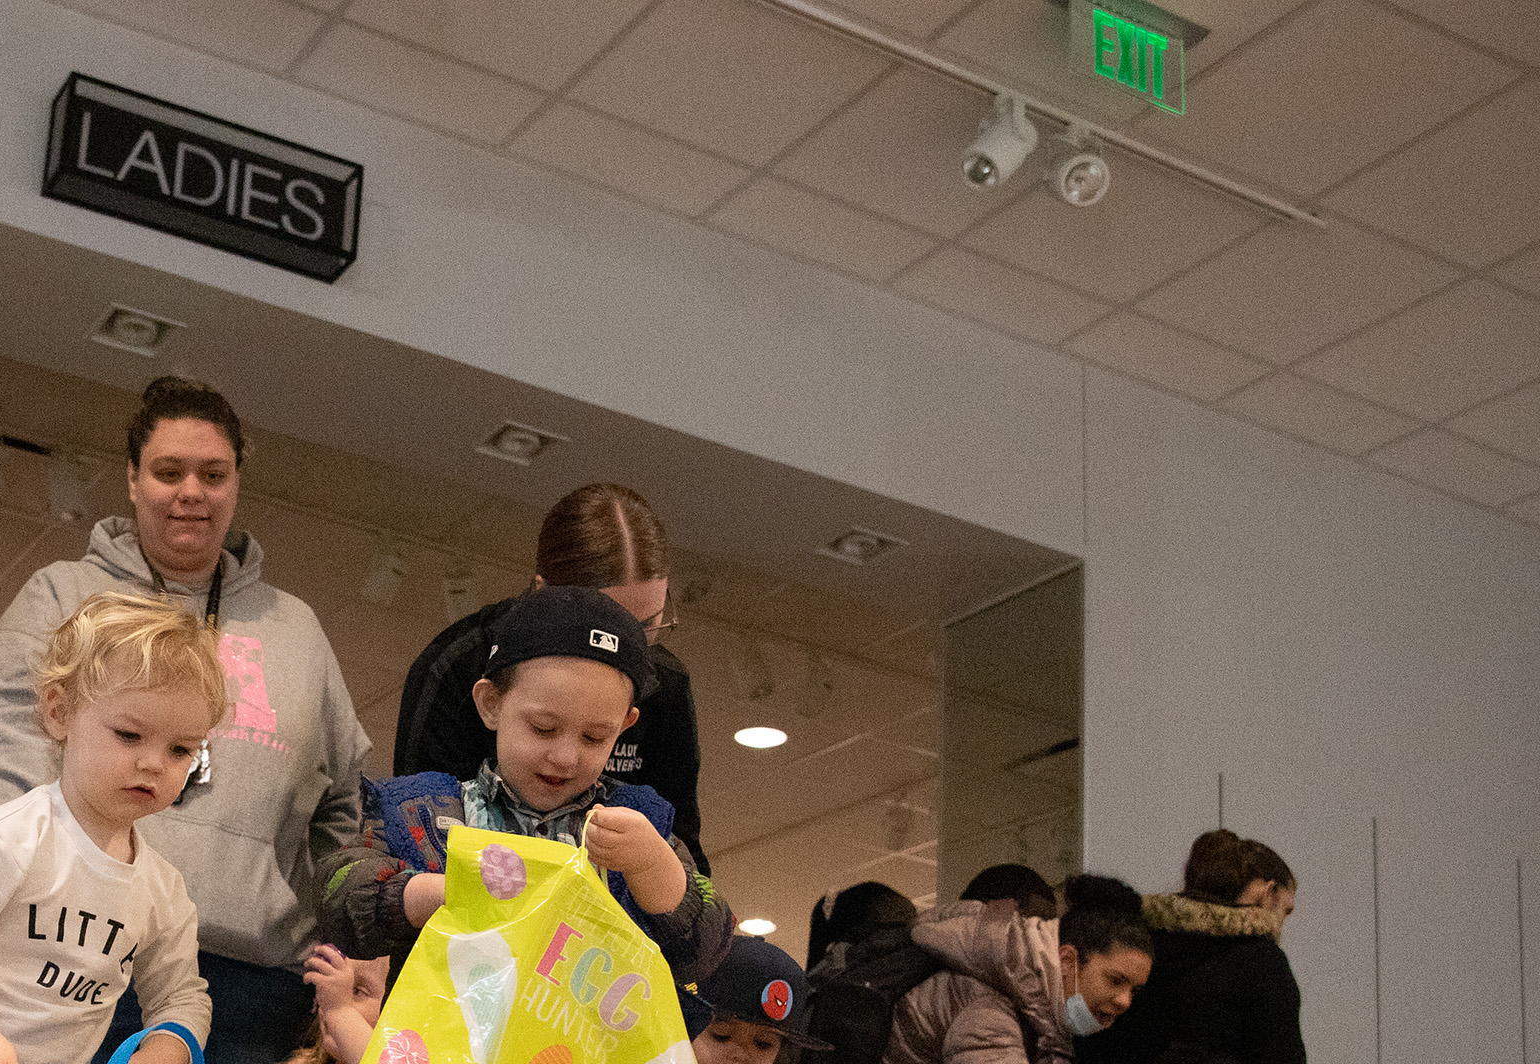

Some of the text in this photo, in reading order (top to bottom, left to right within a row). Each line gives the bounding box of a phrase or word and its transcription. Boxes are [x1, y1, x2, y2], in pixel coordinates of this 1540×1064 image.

[1093, 8, 1168, 100] EXIT
[76, 110, 326, 241] LADIES
[614, 743, 639, 757] LADY
[28, 903, 139, 975] LITT
[534, 921, 653, 1032] EGG
[36, 960, 110, 1006] DUDE
